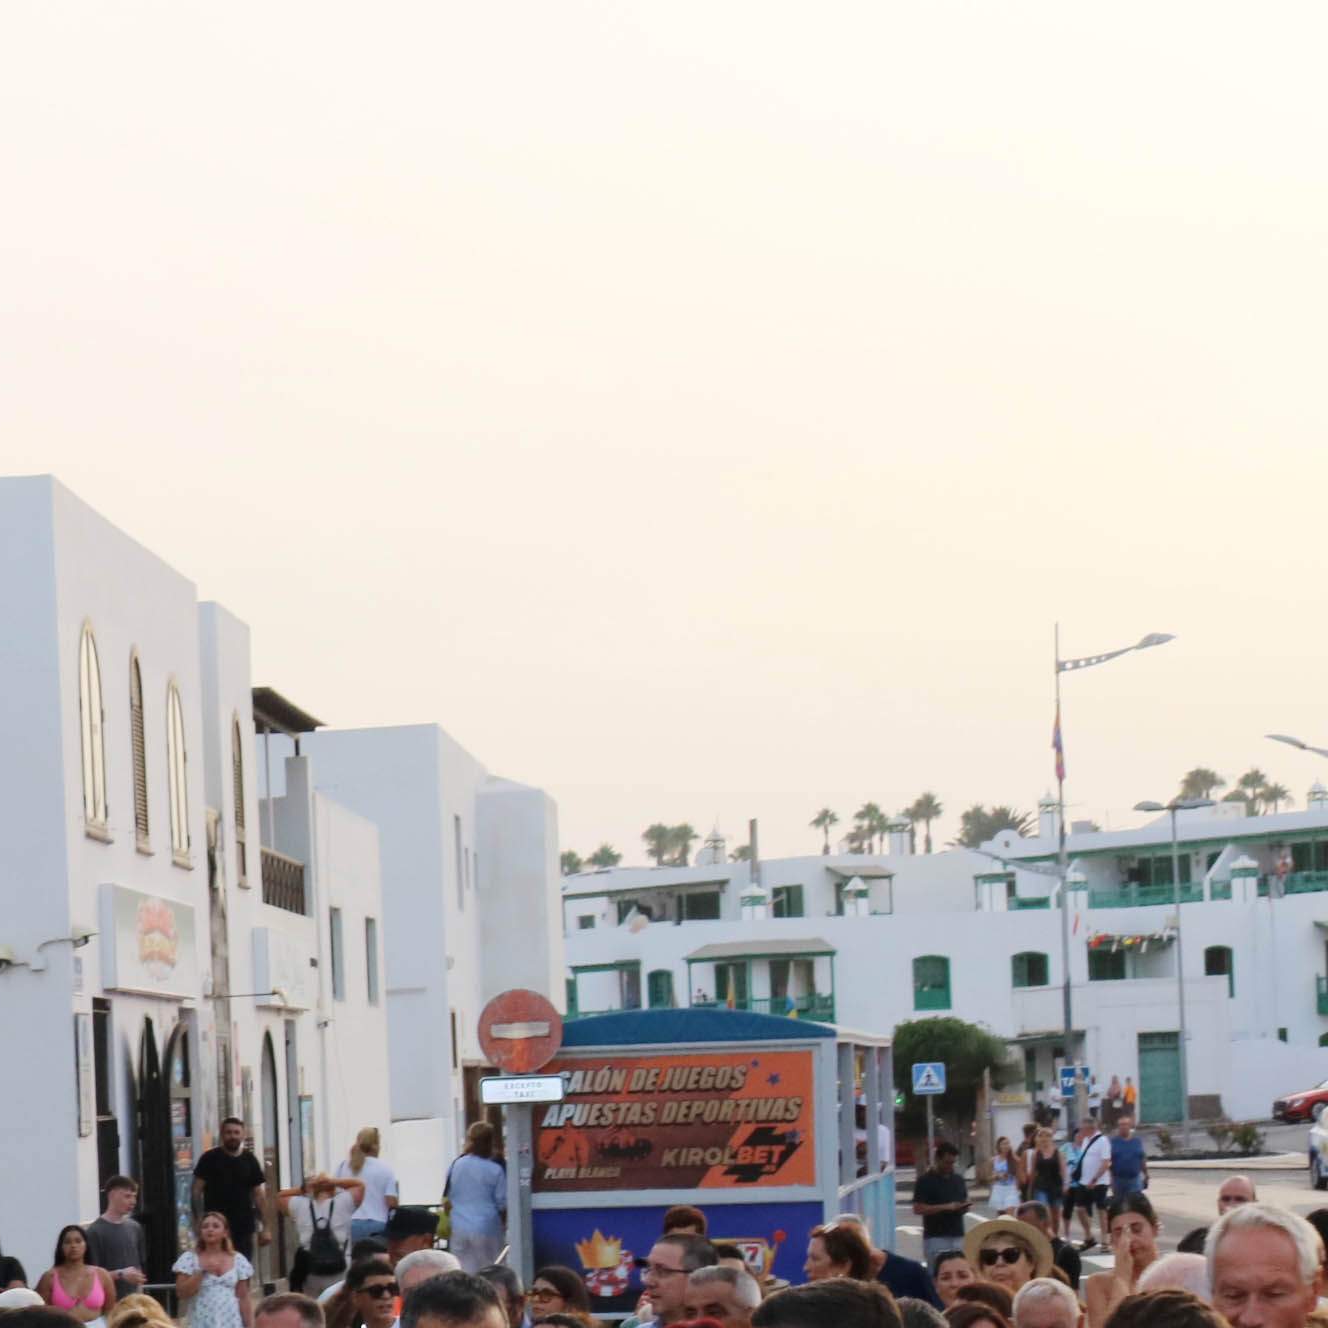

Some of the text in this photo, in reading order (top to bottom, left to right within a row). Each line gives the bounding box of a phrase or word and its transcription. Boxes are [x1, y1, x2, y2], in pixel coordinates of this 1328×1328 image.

[561, 1064, 747, 1096] SALÓN DE JUEGOS
[541, 1097, 803, 1129] APUESTAS DEPORTIVAS
[660, 1145, 784, 1169] KIROLBET
